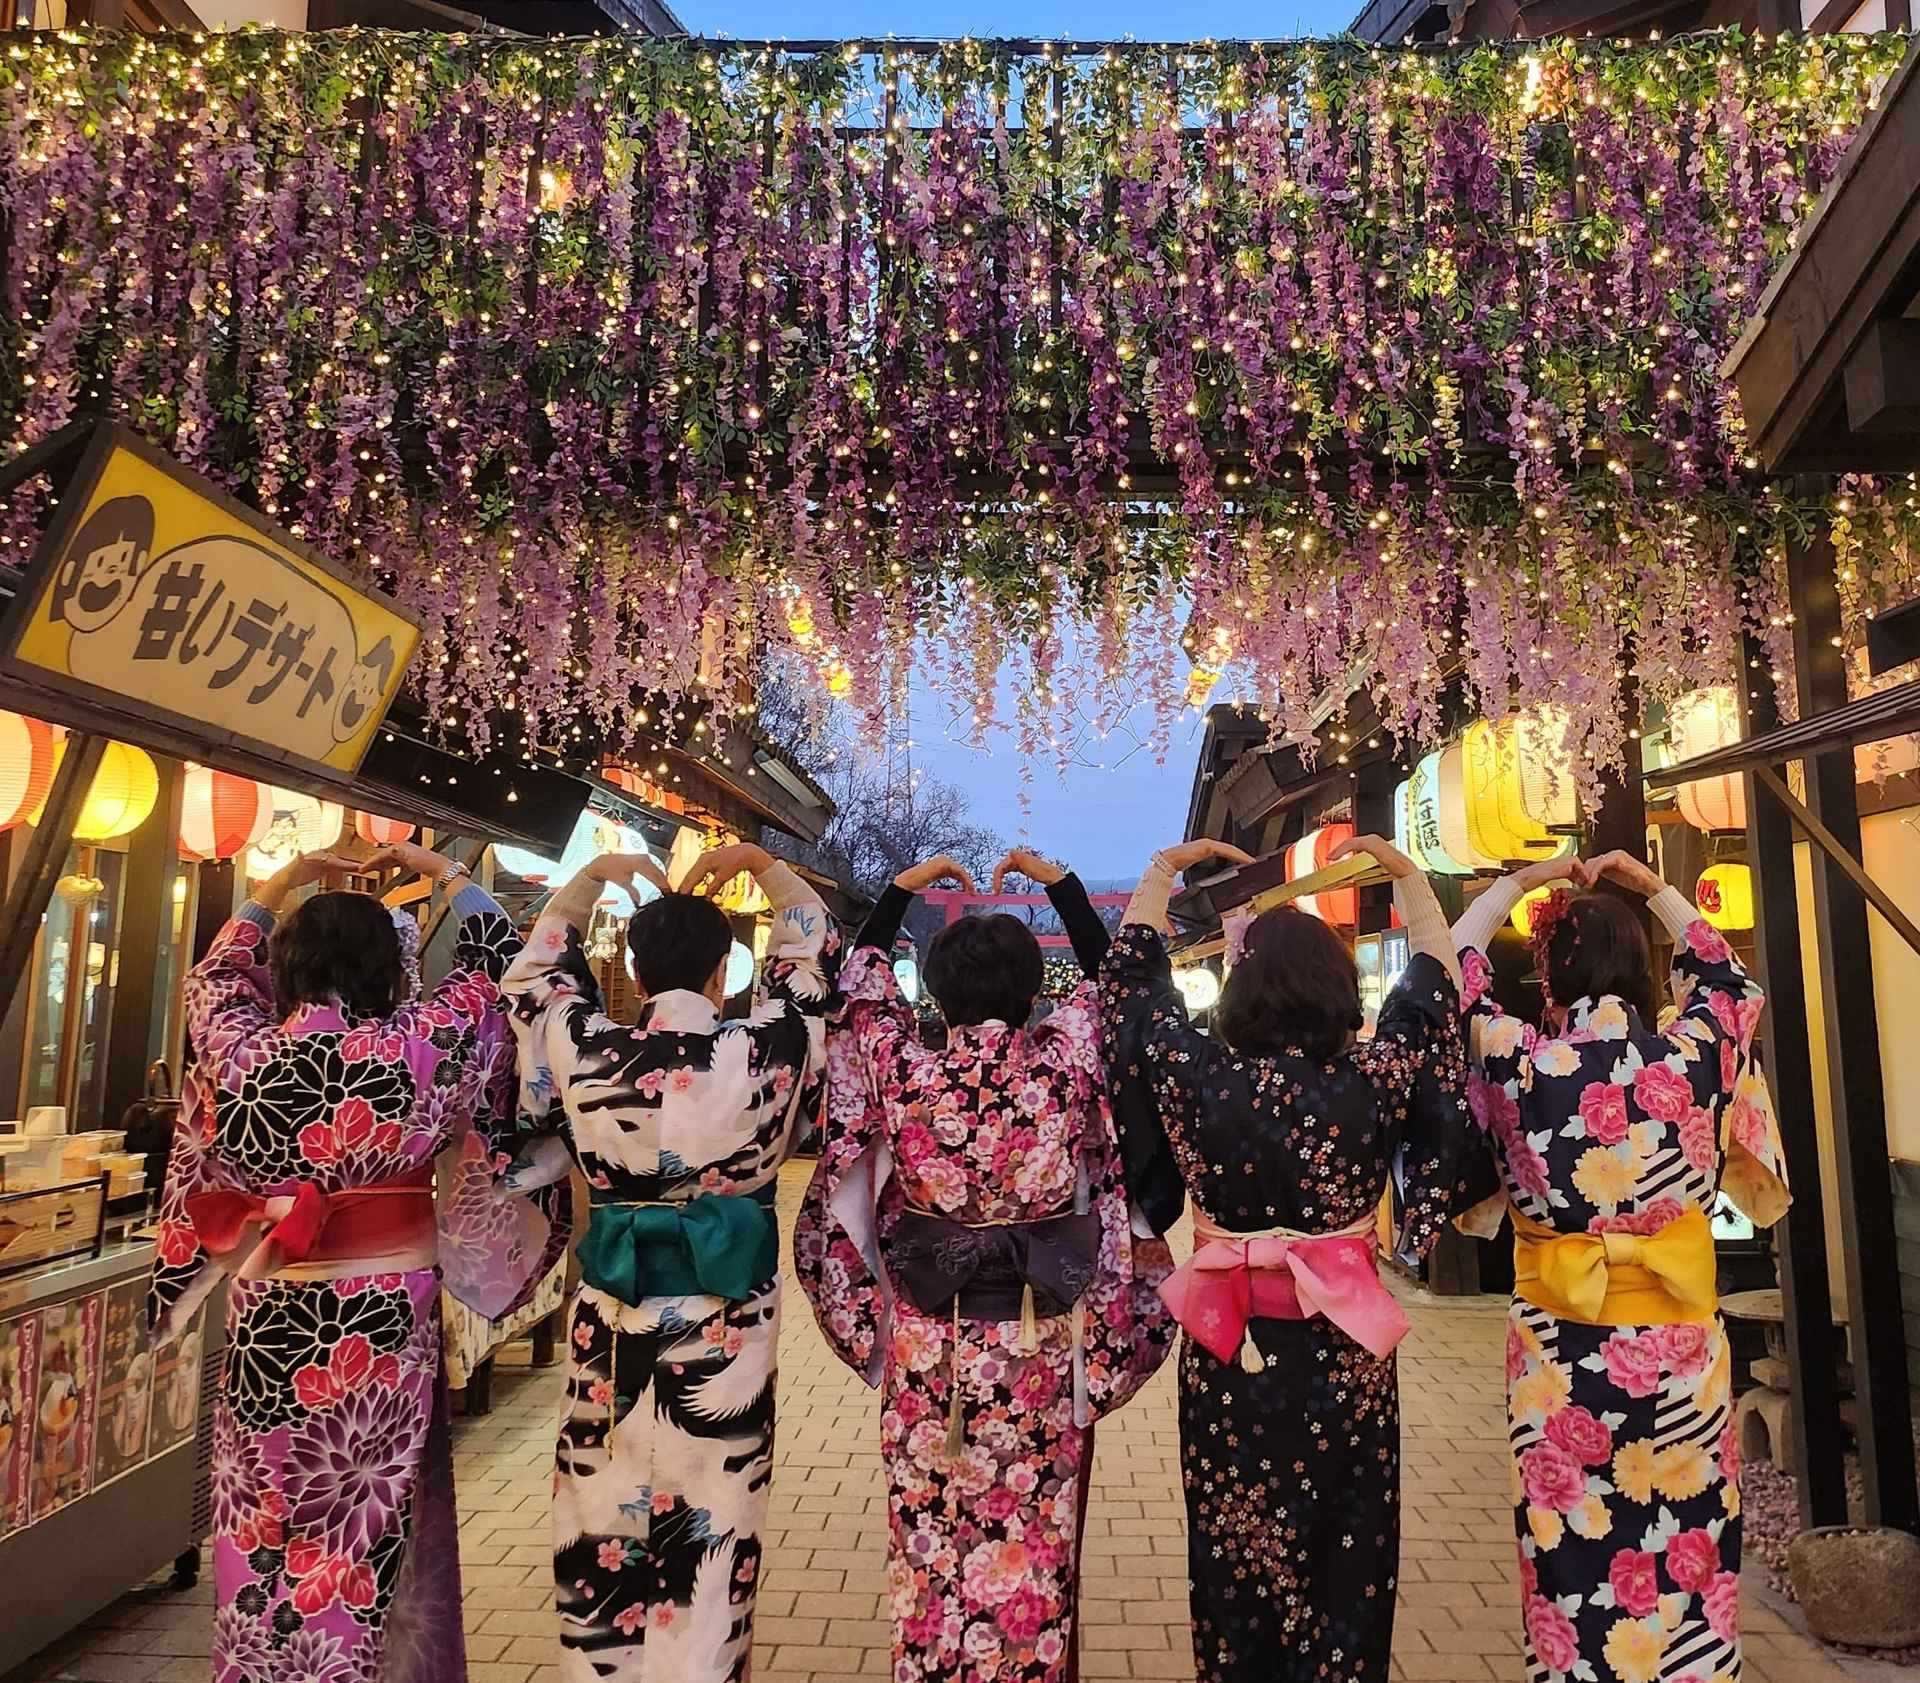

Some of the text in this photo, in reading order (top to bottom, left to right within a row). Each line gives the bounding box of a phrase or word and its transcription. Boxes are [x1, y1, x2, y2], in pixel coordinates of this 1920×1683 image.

[133, 561, 336, 718] 甘いデザート
